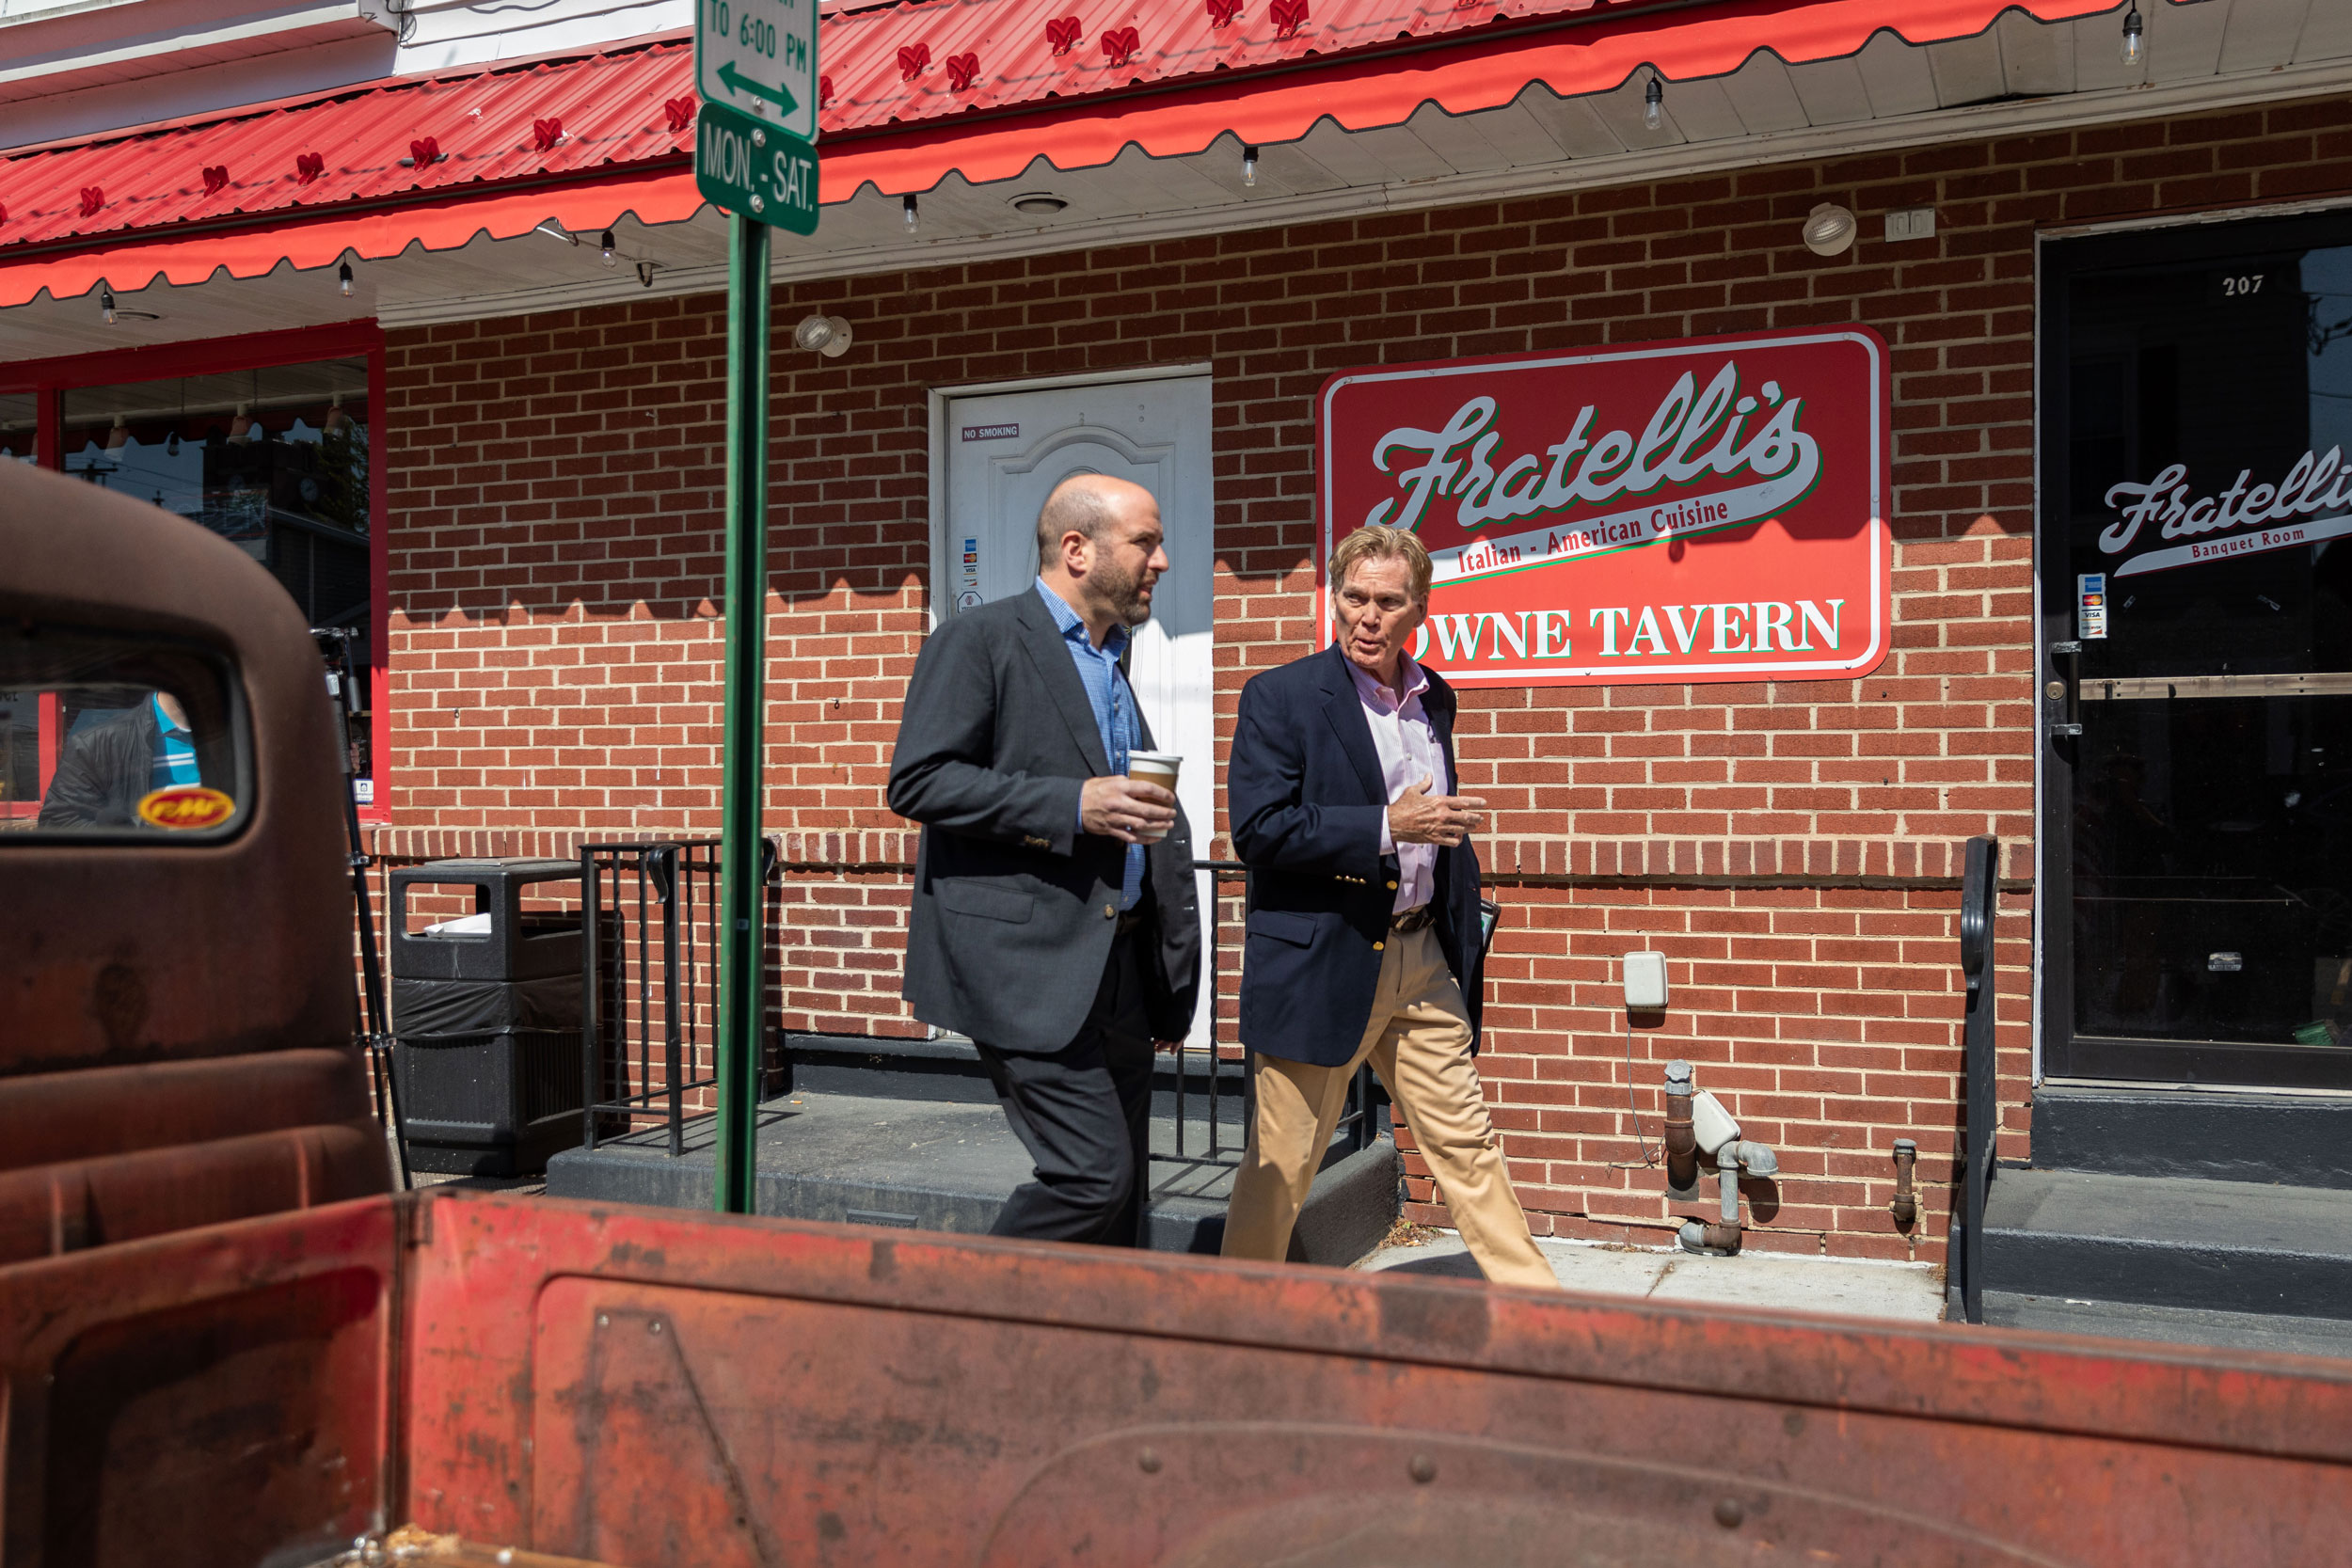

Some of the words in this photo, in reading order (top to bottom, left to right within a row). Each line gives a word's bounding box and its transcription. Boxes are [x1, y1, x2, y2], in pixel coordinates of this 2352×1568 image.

[710, 0, 729, 37] TO
[740, 13, 776, 59] 6:00
[787, 32, 806, 73] PM
[703, 121, 755, 193] MON.
[772, 150, 813, 212] SAT.
[2222, 275, 2265, 296] 207
[964, 429, 977, 439] NO
[978, 425, 1017, 438] SMOKING
[1364, 359, 1820, 530] Fratelli's
[1457, 544, 1521, 573] Italian
[1547, 518, 1642, 556] American
[1651, 499, 1729, 532] Cuisine
[2098, 444, 2352, 555] Fratelli
[2192, 537, 2254, 559] Banquet
[2261, 529, 2305, 546] Room
[1590, 599, 1845, 656] TAVERN
